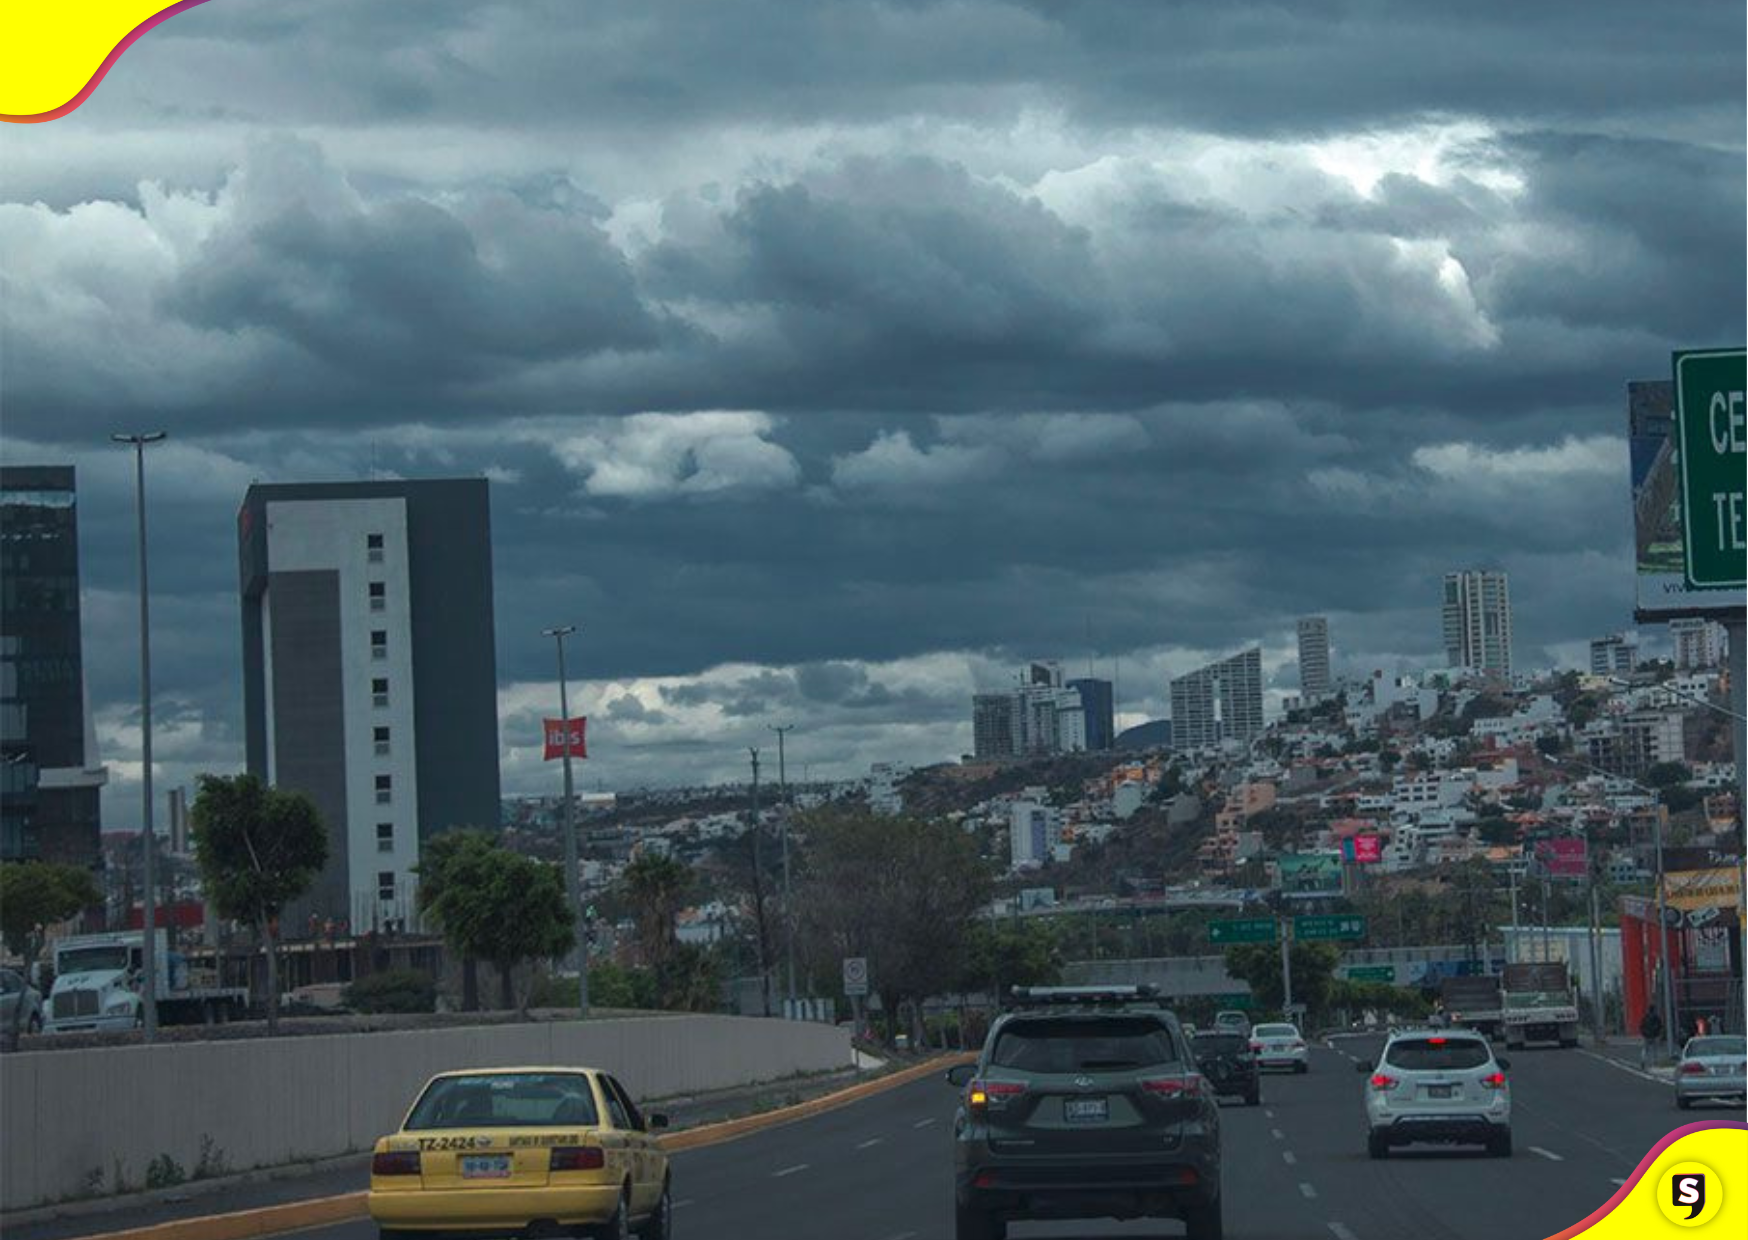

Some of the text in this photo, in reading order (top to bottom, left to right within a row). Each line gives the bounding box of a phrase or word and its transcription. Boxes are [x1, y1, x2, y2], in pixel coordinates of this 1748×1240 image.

[1709, 390, 1746, 455] CE
[1713, 492, 1746, 552] TE
[549, 729, 581, 745] ibs
[418, 1136, 476, 1151] TZ-2424
